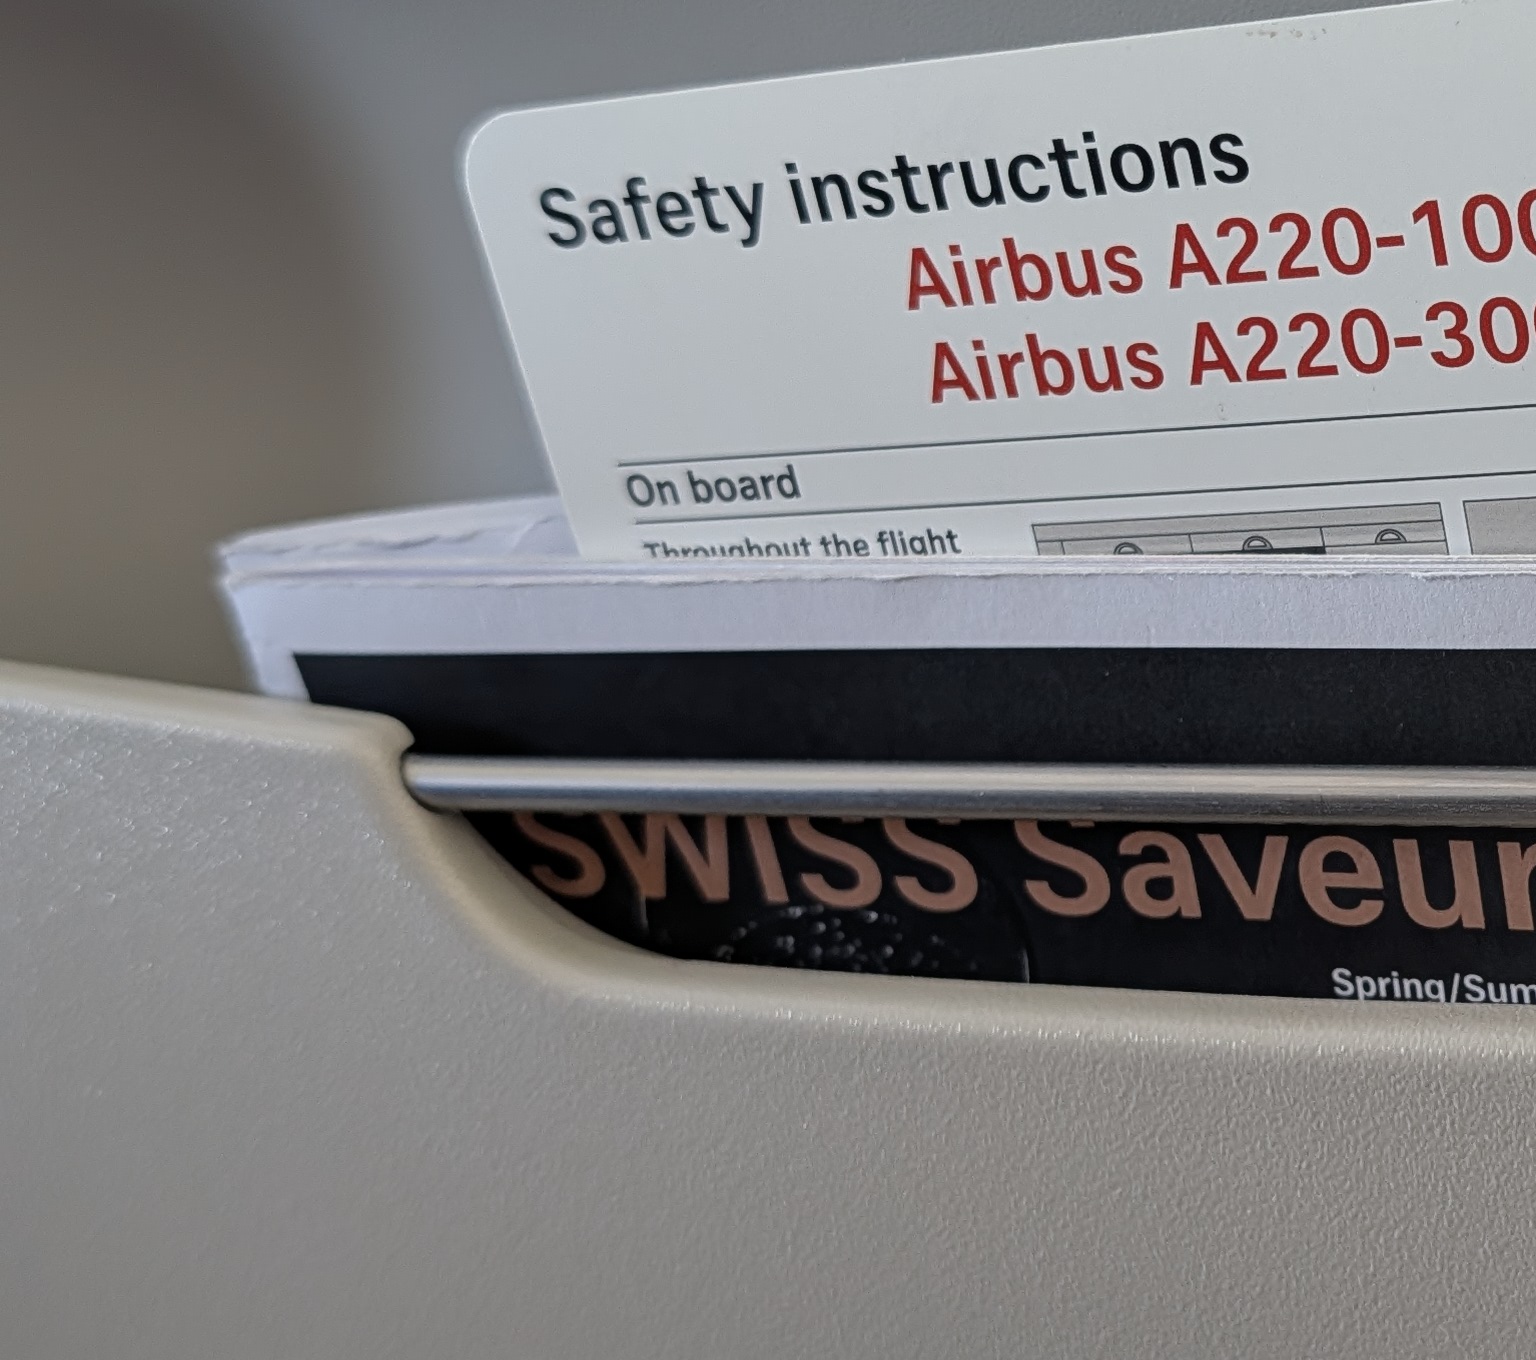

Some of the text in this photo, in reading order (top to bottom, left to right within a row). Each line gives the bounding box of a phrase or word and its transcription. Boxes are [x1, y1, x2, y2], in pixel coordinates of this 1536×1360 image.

[539, 130, 1250, 249] Safety instructions
[907, 236, 1143, 311] Airbus
[930, 332, 1164, 404] Airbus
[625, 463, 803, 508] On board
[819, 533, 870, 557] the
[876, 528, 962, 557] flight
[512, 811, 979, 913] SWISS
